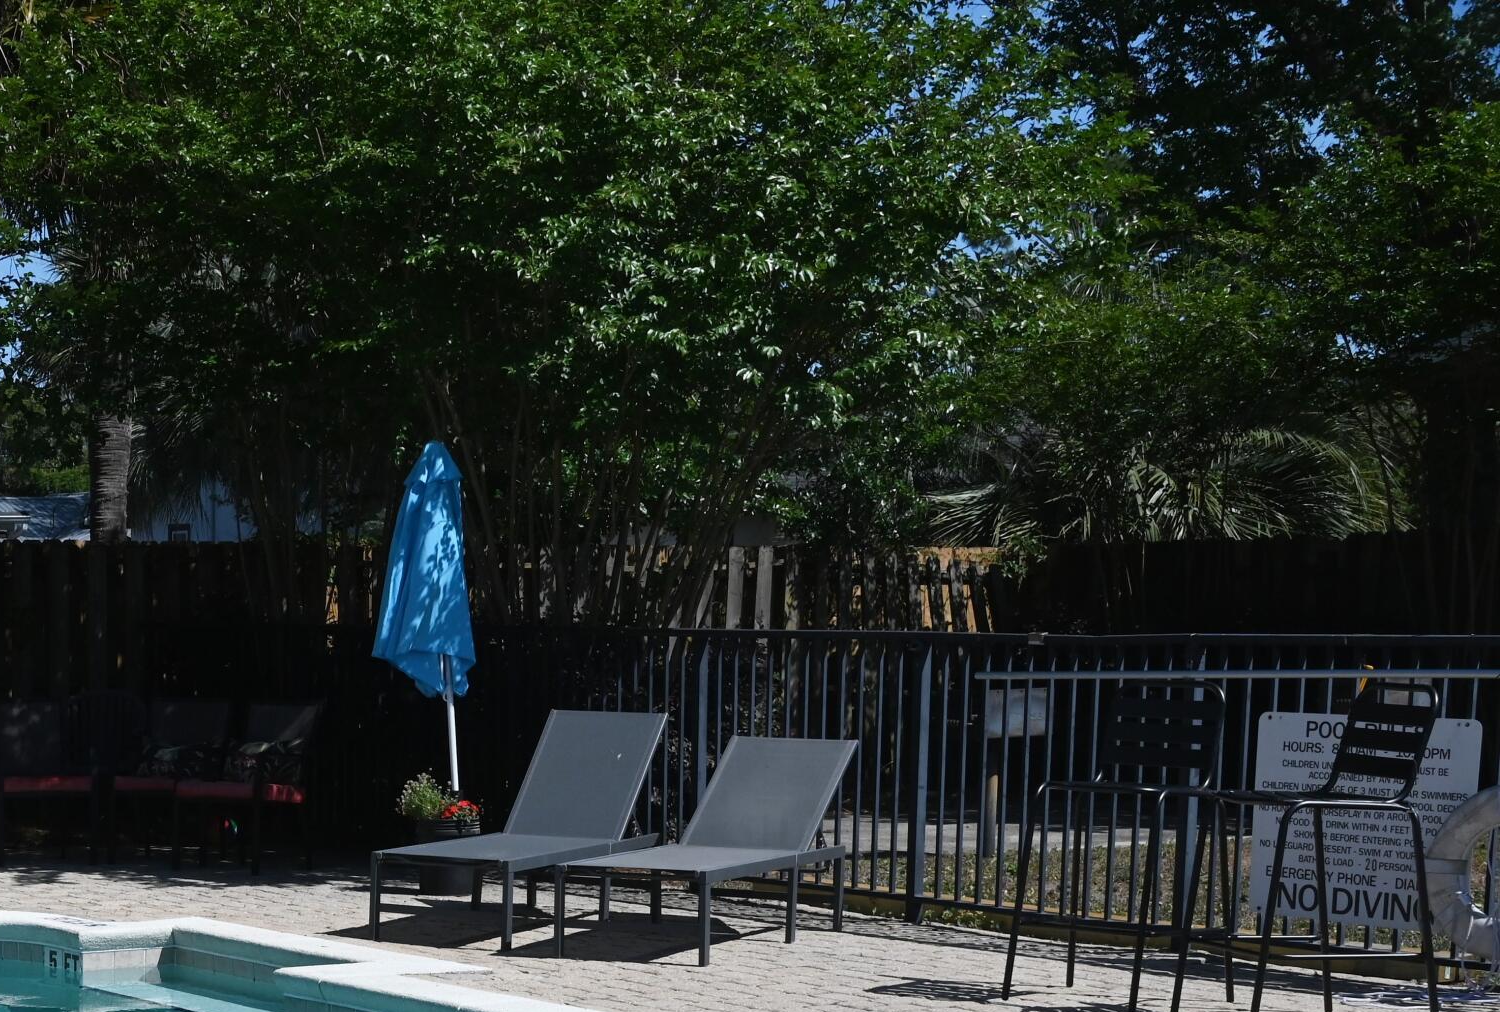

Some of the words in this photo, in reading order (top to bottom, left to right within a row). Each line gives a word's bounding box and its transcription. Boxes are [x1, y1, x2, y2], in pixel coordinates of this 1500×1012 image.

[1306, 720, 1346, 739] POO
[1283, 741, 1325, 754] HOURS:
[1282, 759, 1319, 769] CHILDREN
[1417, 767, 1436, 776] UST
[1438, 767, 1449, 776] BE
[1308, 771, 1364, 782] ACCOANIED
[1262, 781, 1299, 791] CHILDREN
[1348, 786, 1359, 794] OF
[1361, 786, 1366, 795] 3
[1368, 787, 1391, 797] MUST
[1421, 790, 1469, 801] SWIMMERS
[1363, 811, 1371, 819] IN
[1373, 812, 1384, 820] OR
[1422, 815, 1443, 825] POOL
[1325, 821, 1349, 831] DRINK
[1352, 822, 1380, 832] WITHIN
[1382, 825, 1387, 833] 4
[1390, 826, 1411, 834] FEET
[1330, 833, 1359, 843] BEFORE
[1362, 835, 1401, 846] ENTERING
[1259, 840, 1271, 848] NO
[1273, 840, 1314, 851] LEGUARD
[1323, 844, 1351, 854] RESENT
[1359, 847, 1381, 857] SWIM
[1383, 849, 1392, 858] AT
[1298, 854, 1330, 865] BATHG
[1333, 858, 1354, 867] LOAD
[1365, 858, 1377, 871] 20
[1379, 862, 1416, 873] PERSON
[1265, 865, 1334, 883] EERGENY
[1337, 872, 1377, 887] PHONE
[1395, 877, 1418, 891] DIA
[1277, 881, 1319, 912] NO
[49, 950, 58, 968] 5
[64, 952, 80, 972] FT
